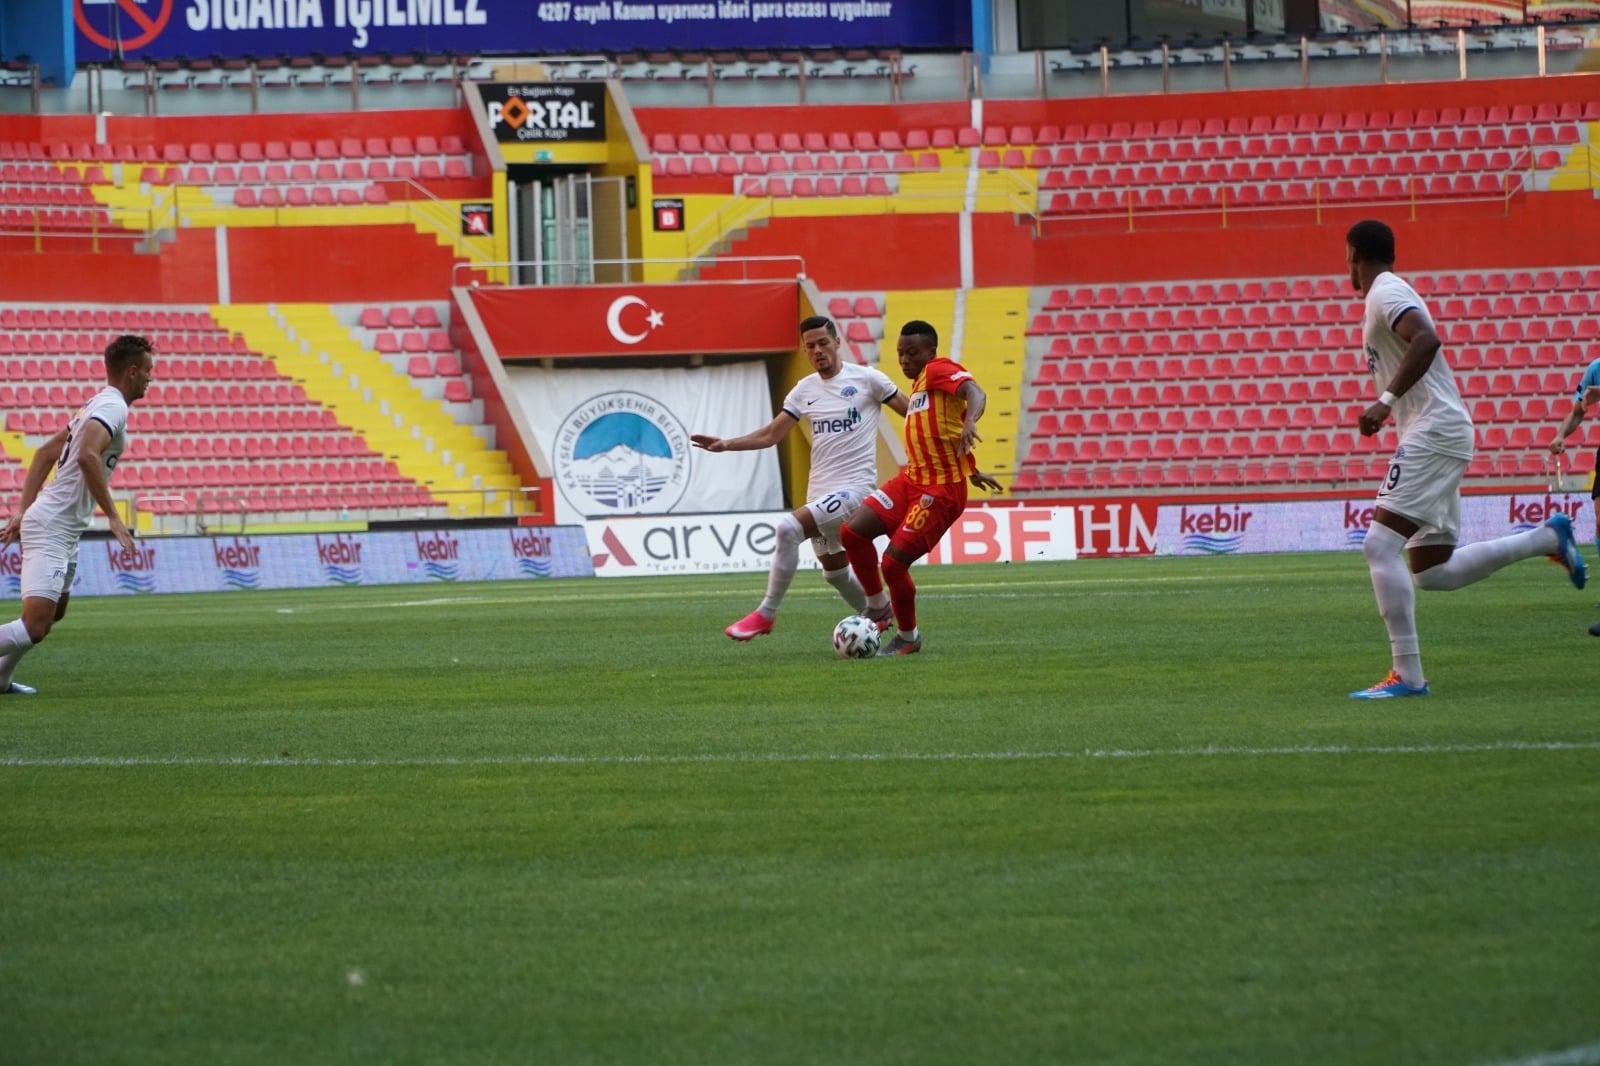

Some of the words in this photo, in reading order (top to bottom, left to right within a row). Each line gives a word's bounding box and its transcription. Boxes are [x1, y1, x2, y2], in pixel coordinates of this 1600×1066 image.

[613, 1, 655, 20] Kanun
[657, 4, 716, 24] uyarınca
[752, 3, 784, 22] para
[785, 3, 828, 18] cezası
[830, 1, 892, 22] uygulanır
[487, 96, 596, 129] PORTAL
[822, 494, 842, 514] 10
[905, 503, 930, 530] 86
[1180, 504, 1253, 534] kebir
[212, 536, 260, 569] kebir
[315, 533, 362, 565] kebir
[414, 530, 459, 561] kebir
[509, 527, 552, 558] kebir
[695, 559, 747, 571] Yapmak
